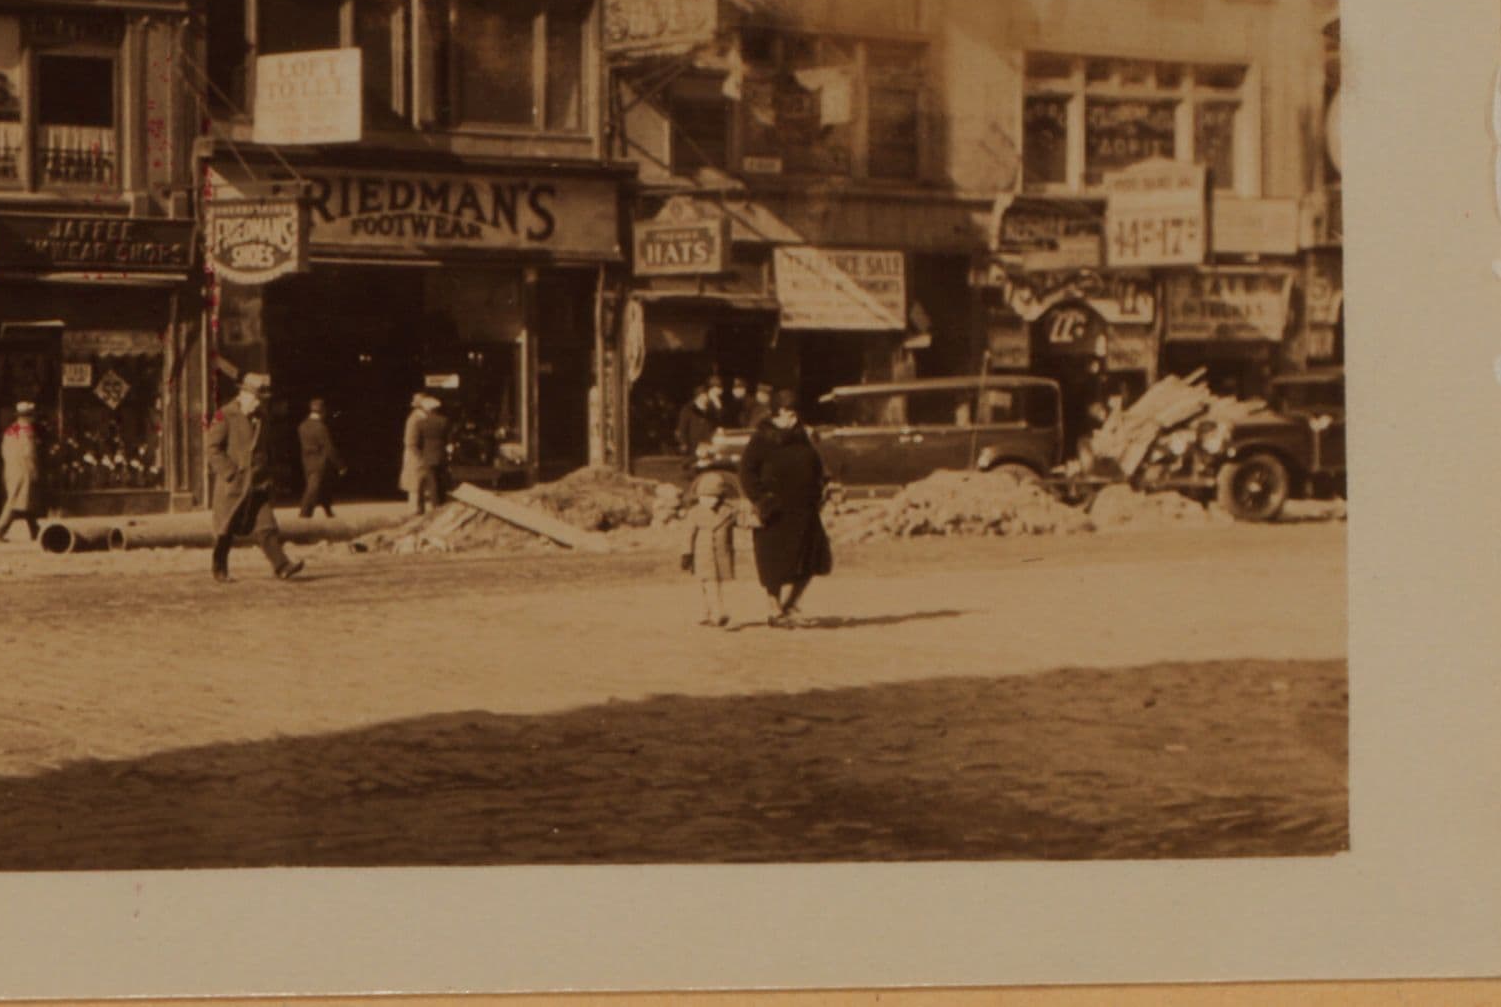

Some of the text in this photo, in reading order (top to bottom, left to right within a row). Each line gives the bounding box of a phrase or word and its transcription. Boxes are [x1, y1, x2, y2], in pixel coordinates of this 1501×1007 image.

[297, 176, 556, 242] RIEDMAN'S
[351, 212, 482, 239] FOOTWEAR
[645, 240, 708, 264] HATS
